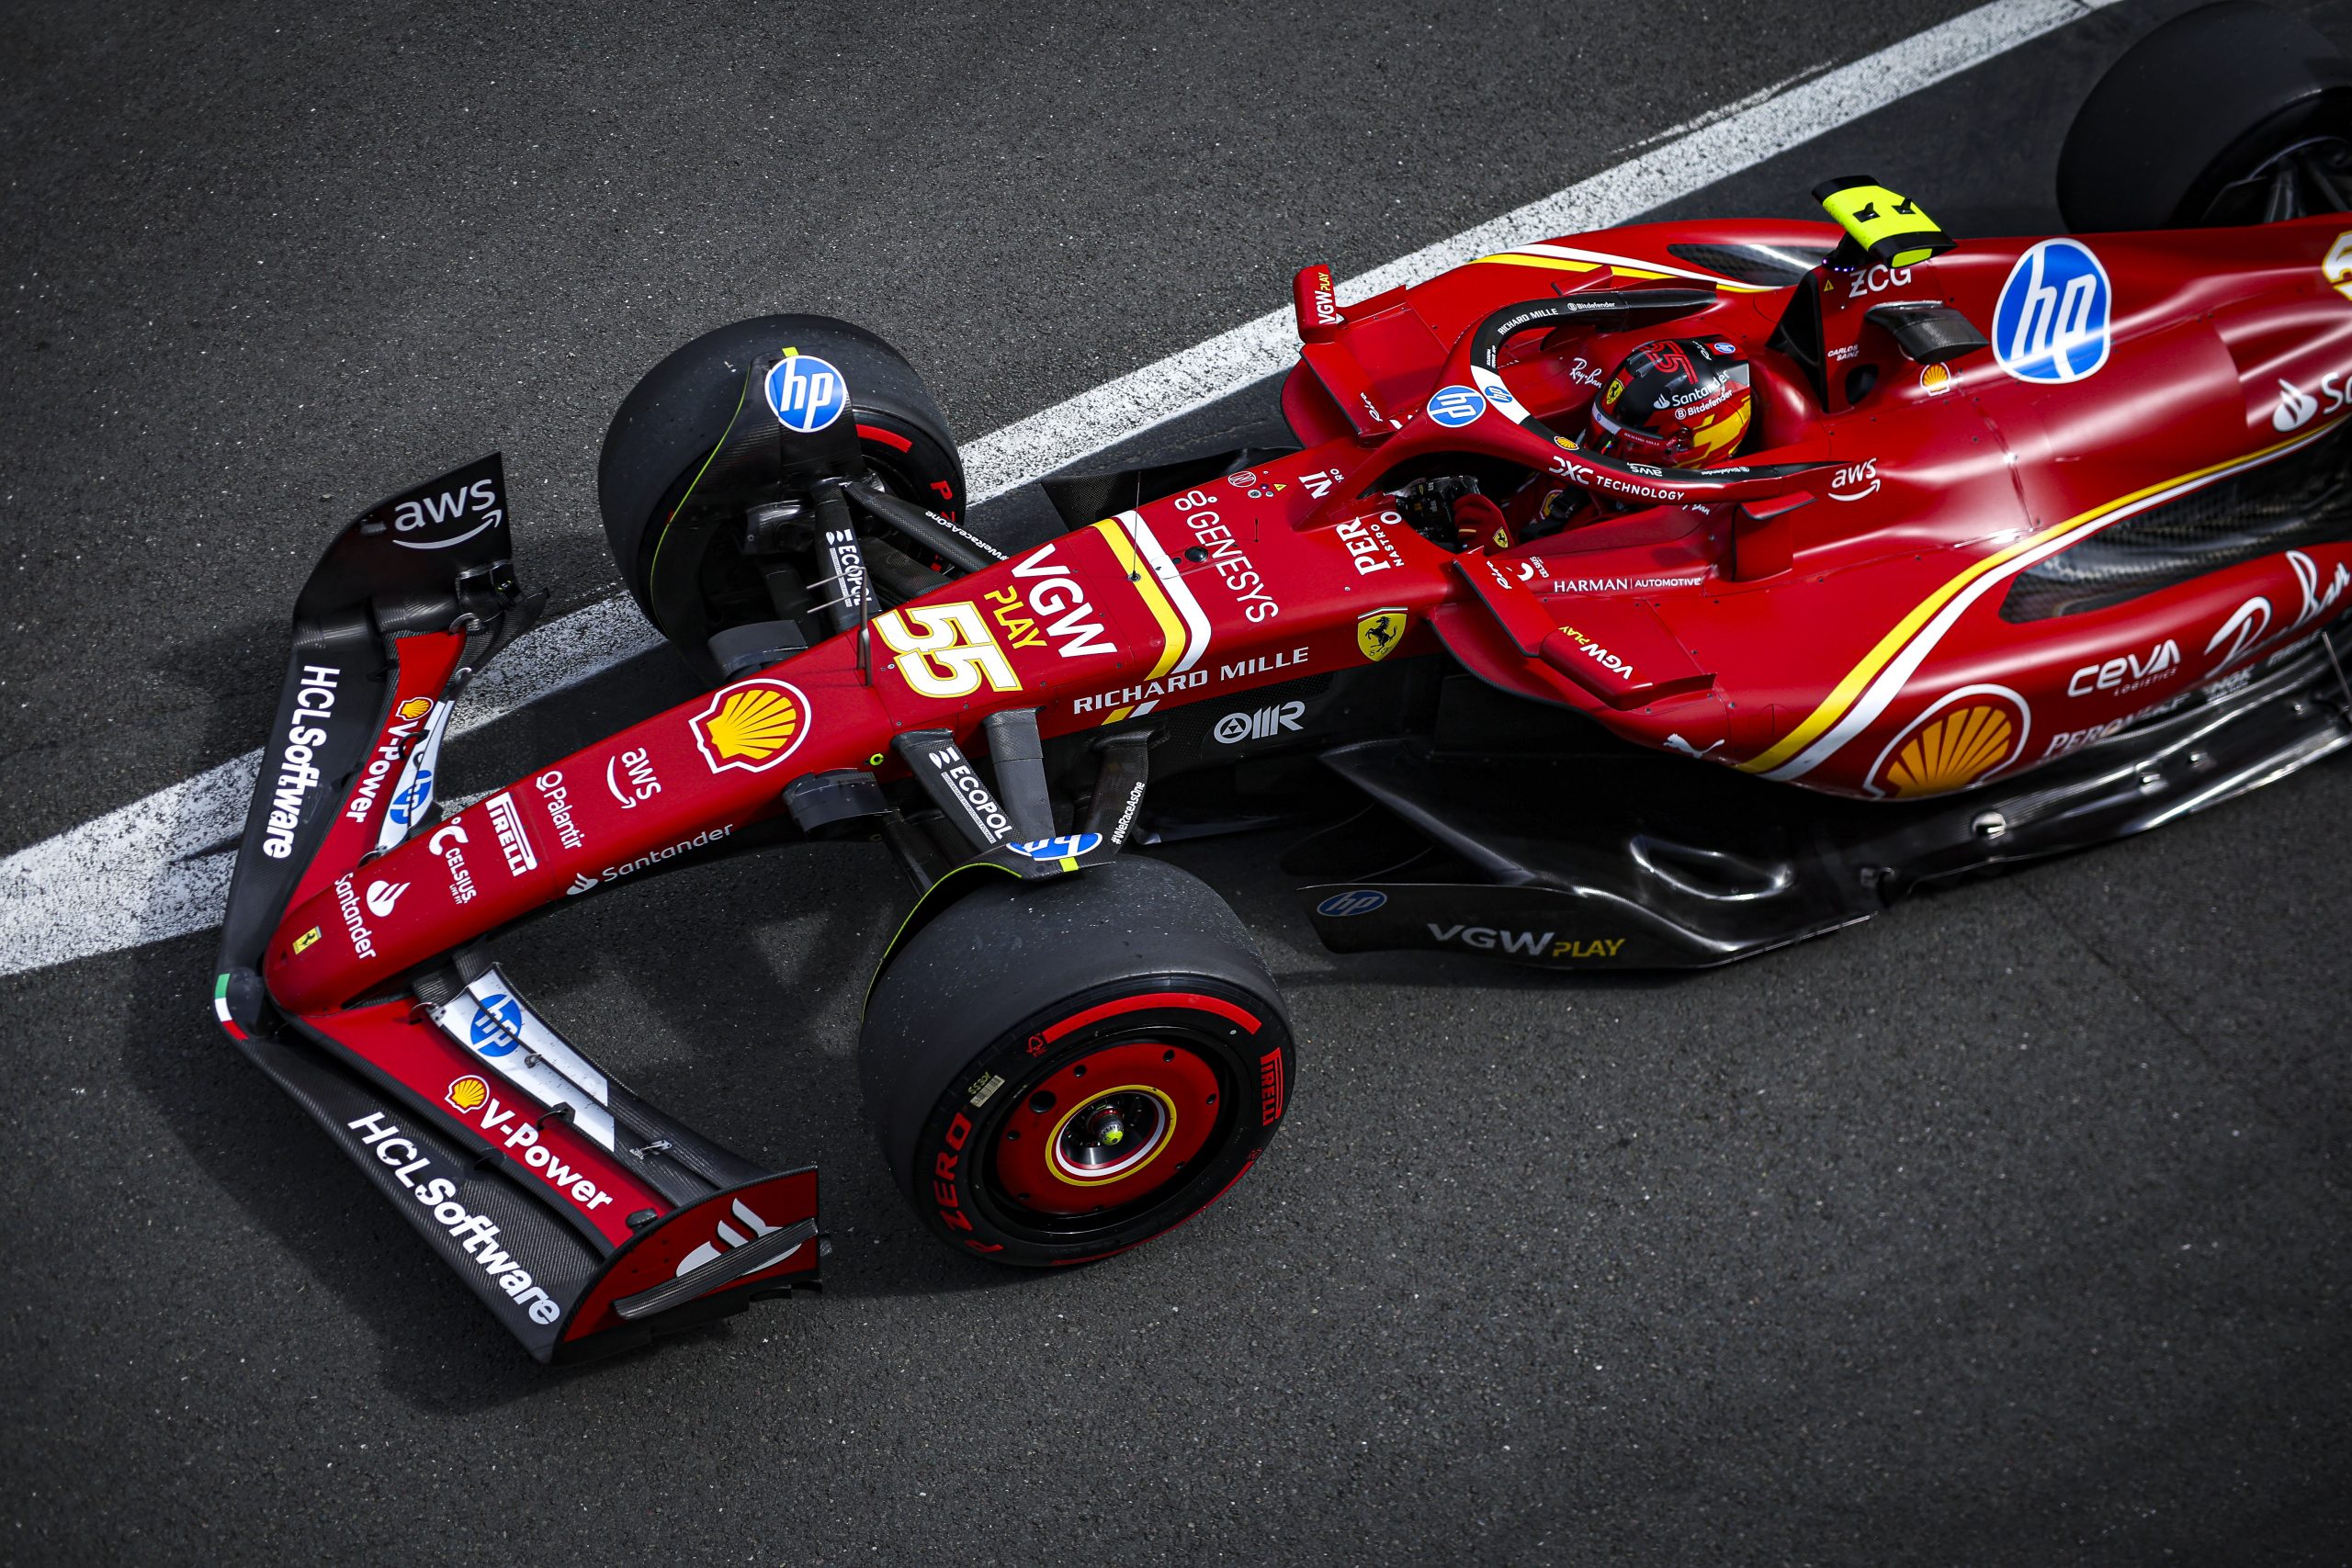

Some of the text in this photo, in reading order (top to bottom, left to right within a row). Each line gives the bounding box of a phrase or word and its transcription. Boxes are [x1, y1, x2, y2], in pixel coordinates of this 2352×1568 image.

[1315, 272, 1337, 324] VGW PLAY
[1497, 308, 1559, 335] RICHARD MILLE
[2010, 243, 2097, 382] hp
[1827, 344, 1859, 357] CARLOS
[1837, 350, 1860, 362] SAINZ
[779, 356, 834, 430] hp
[1430, 392, 1484, 419] hp
[1671, 369, 1731, 407] Santander
[1687, 389, 1733, 416] Bitdefender
[1596, 475, 1685, 501] TECHNOLOGY
[1832, 457, 1877, 490] aws
[394, 479, 495, 532] aws
[925, 510, 1010, 560] #WeRaceAsOne
[1187, 510, 1279, 624] GENESYS
[1370, 524, 1405, 567] NASTRO
[1012, 544, 1117, 659] VGW
[1554, 577, 1702, 593] HARMAN AUTOMOTIVE
[984, 584, 1048, 649] PLAY
[872, 601, 1023, 699] 55
[1557, 626, 1634, 680] VGW PLAY
[1073, 646, 1309, 715] RICHARD MILLE
[2114, 668, 2179, 695] LOGISTICS
[264, 665, 340, 858] HCLSoftware
[345, 720, 419, 823] V-Power
[621, 747, 662, 801] aws
[543, 786, 583, 849] Palantir
[949, 765, 1012, 840] ECOPOL
[1111, 781, 1146, 845] #WeRaceAsOne
[485, 792, 537, 876] PIRELLI
[602, 824, 733, 883] Santander
[334, 873, 377, 959] Santander
[1329, 890, 1376, 917] hp
[1427, 923, 1626, 958] VGW PLAY
[1260, 1046, 1284, 1126] PIRELLI
[480, 1098, 613, 1212] V-Power
[933, 1111, 973, 1231] ZERO
[347, 1110, 560, 1325] HCLSoftware
